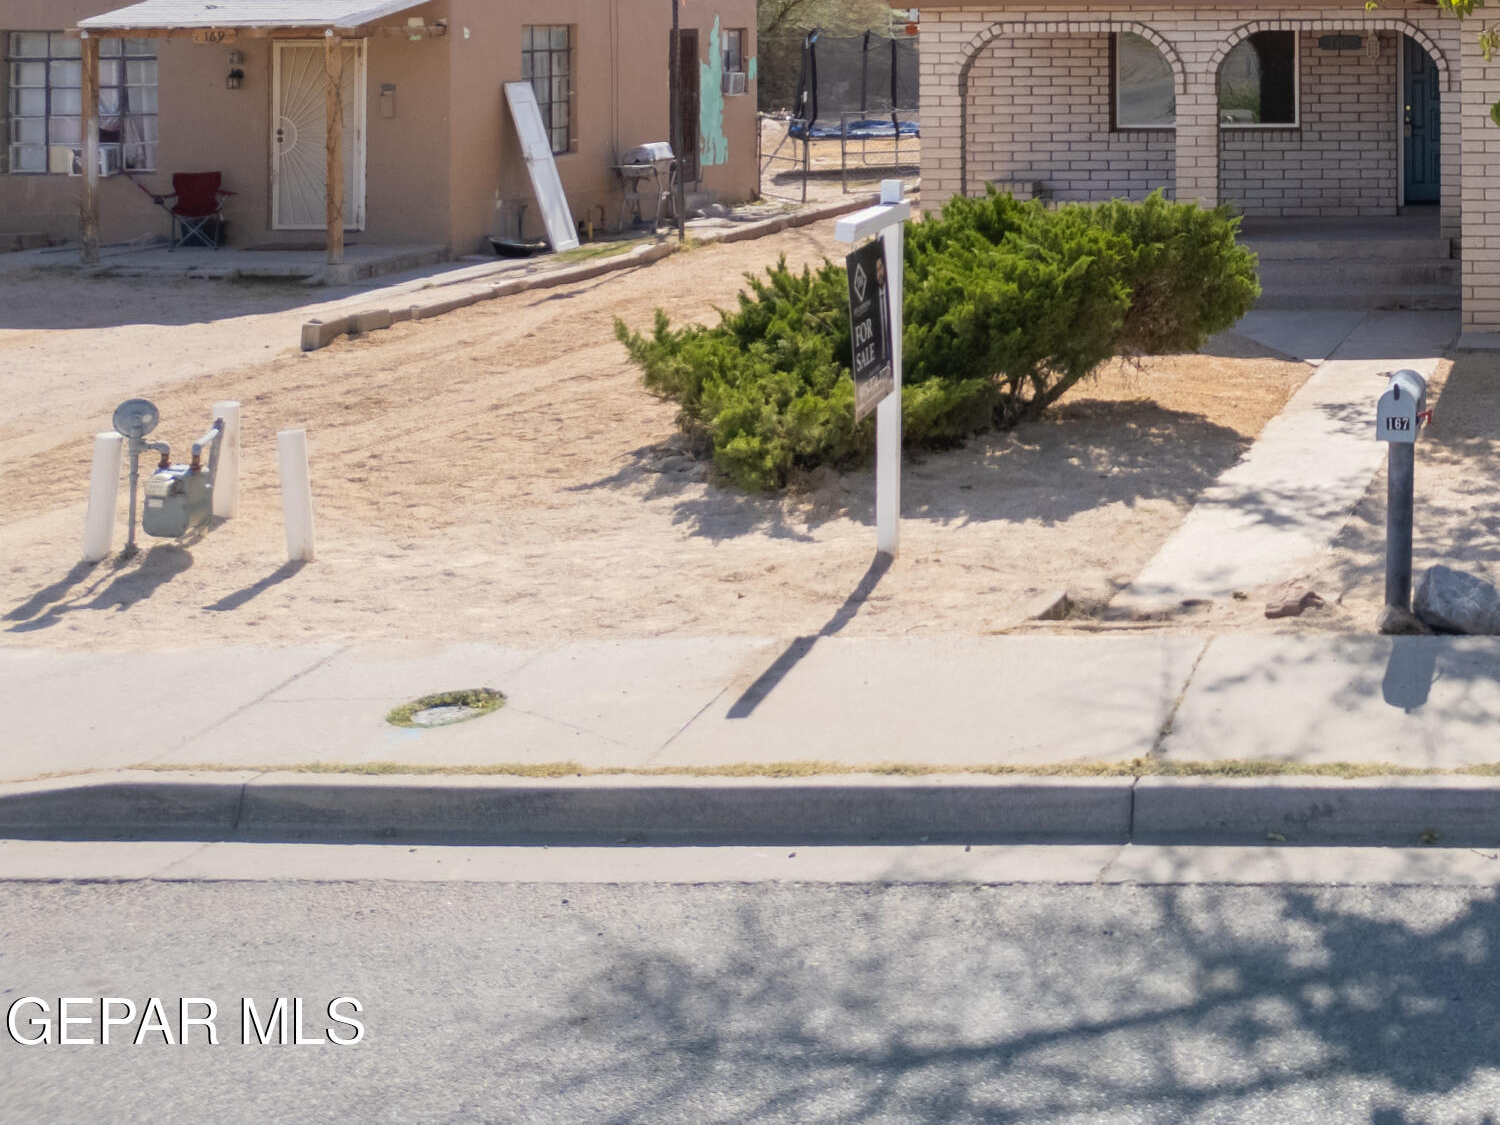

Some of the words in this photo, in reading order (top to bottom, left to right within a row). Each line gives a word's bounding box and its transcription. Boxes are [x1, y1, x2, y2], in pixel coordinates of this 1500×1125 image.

[204, 30, 225, 44] 169
[855, 318, 873, 347] FOR
[856, 342, 875, 372] SALE
[1388, 417, 1409, 430] 167
